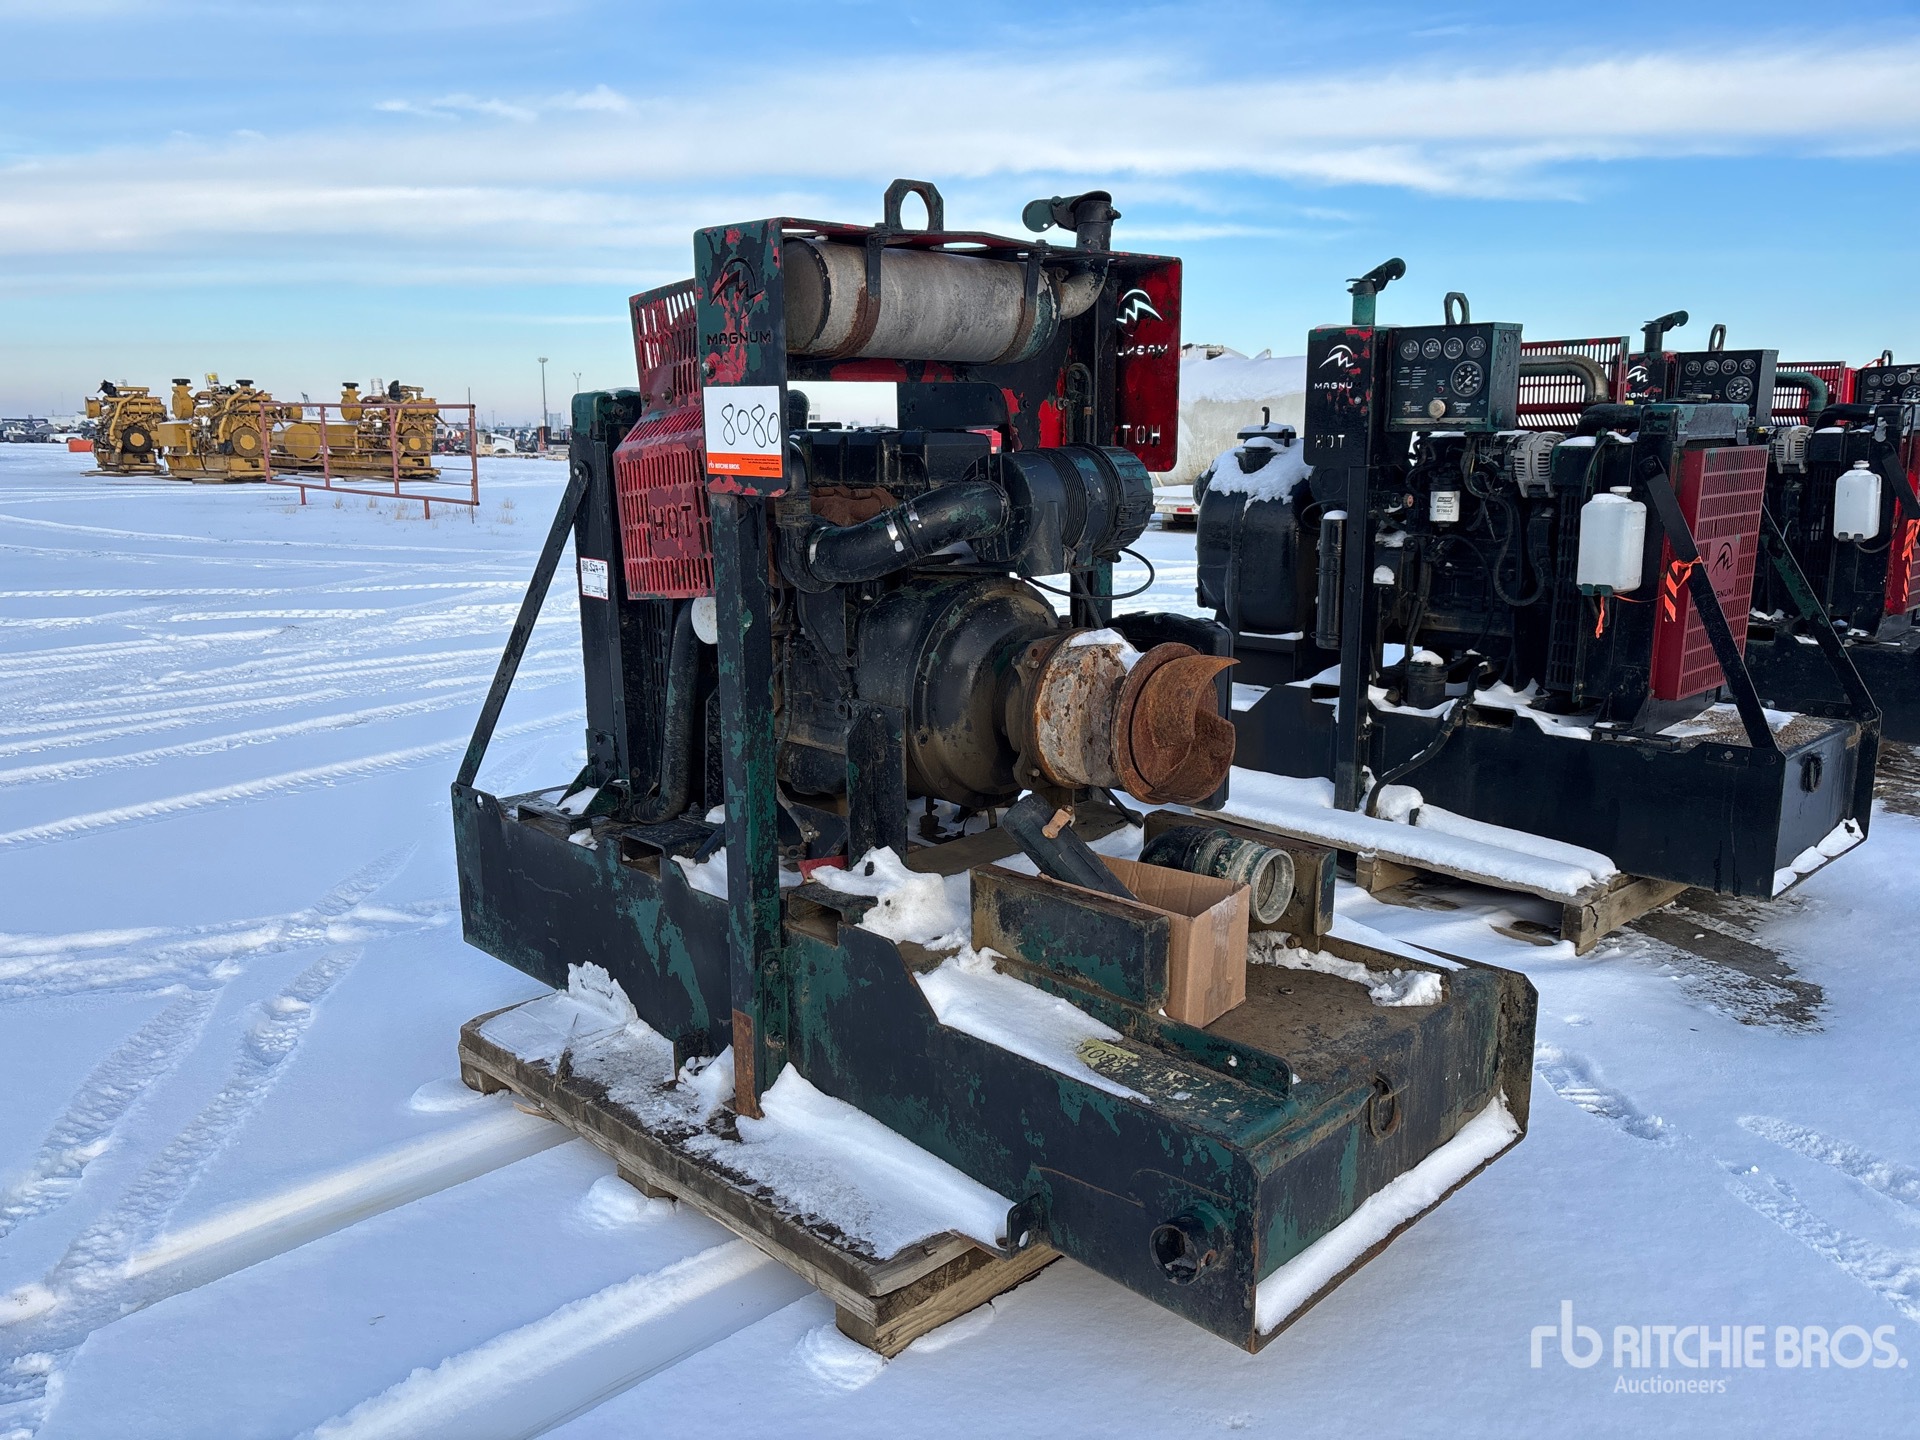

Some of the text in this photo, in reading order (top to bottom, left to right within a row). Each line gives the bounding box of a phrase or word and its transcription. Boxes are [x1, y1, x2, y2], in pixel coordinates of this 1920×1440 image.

[706, 330, 771, 345] MAGNUM
[721, 403, 780, 448] 8080
[1315, 434, 1345, 449] HOT
[652, 505, 692, 540] HOT
[1715, 587, 1734, 599] GNUM
